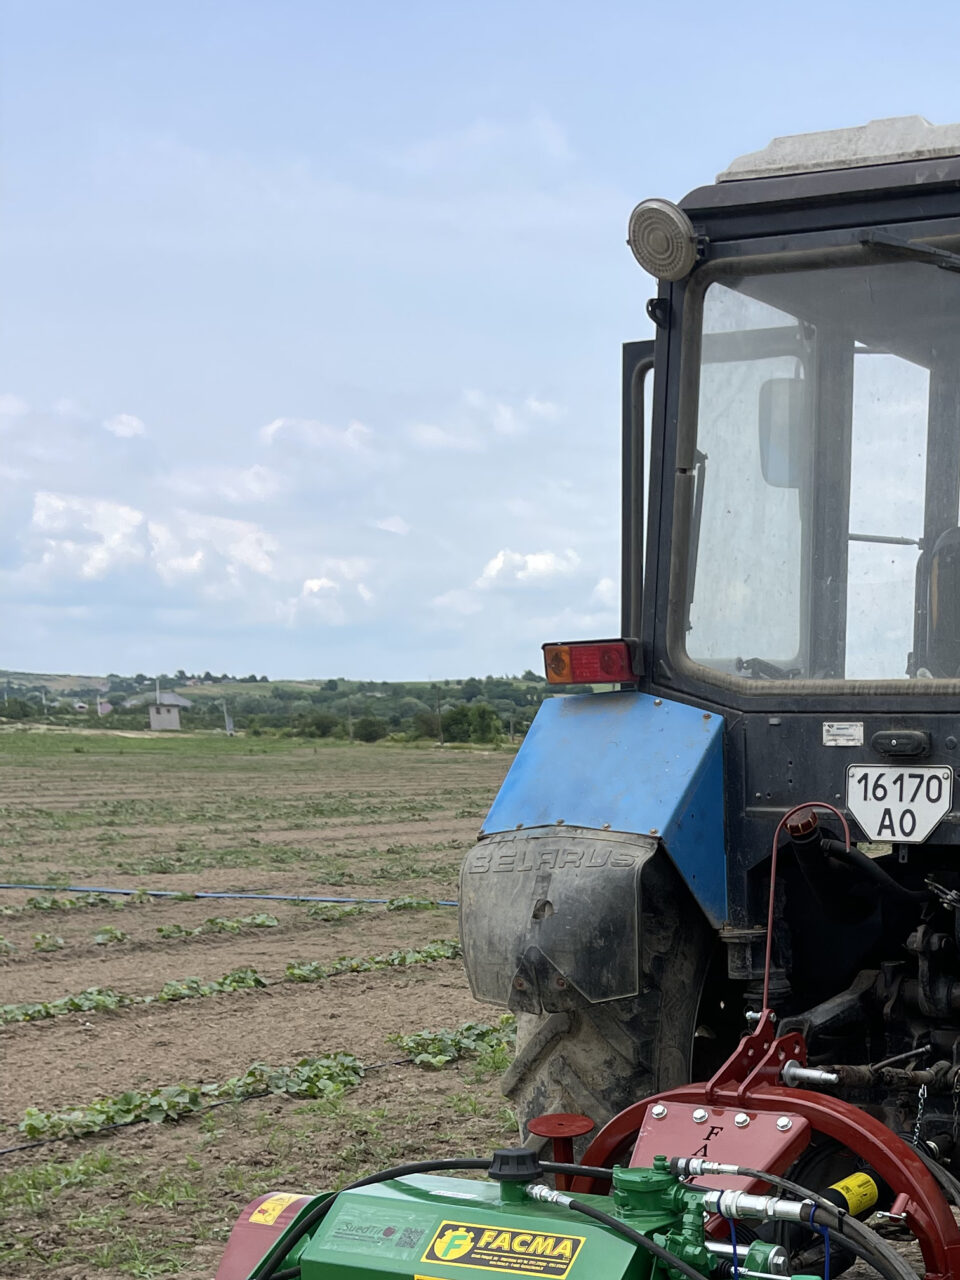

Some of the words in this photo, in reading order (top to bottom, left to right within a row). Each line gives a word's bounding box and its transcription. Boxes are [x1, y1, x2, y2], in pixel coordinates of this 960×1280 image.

[857, 772, 943, 803] 16170
[877, 808, 917, 837] AO
[469, 848, 639, 875] BELARUS
[476, 1229, 573, 1259] FACMA
